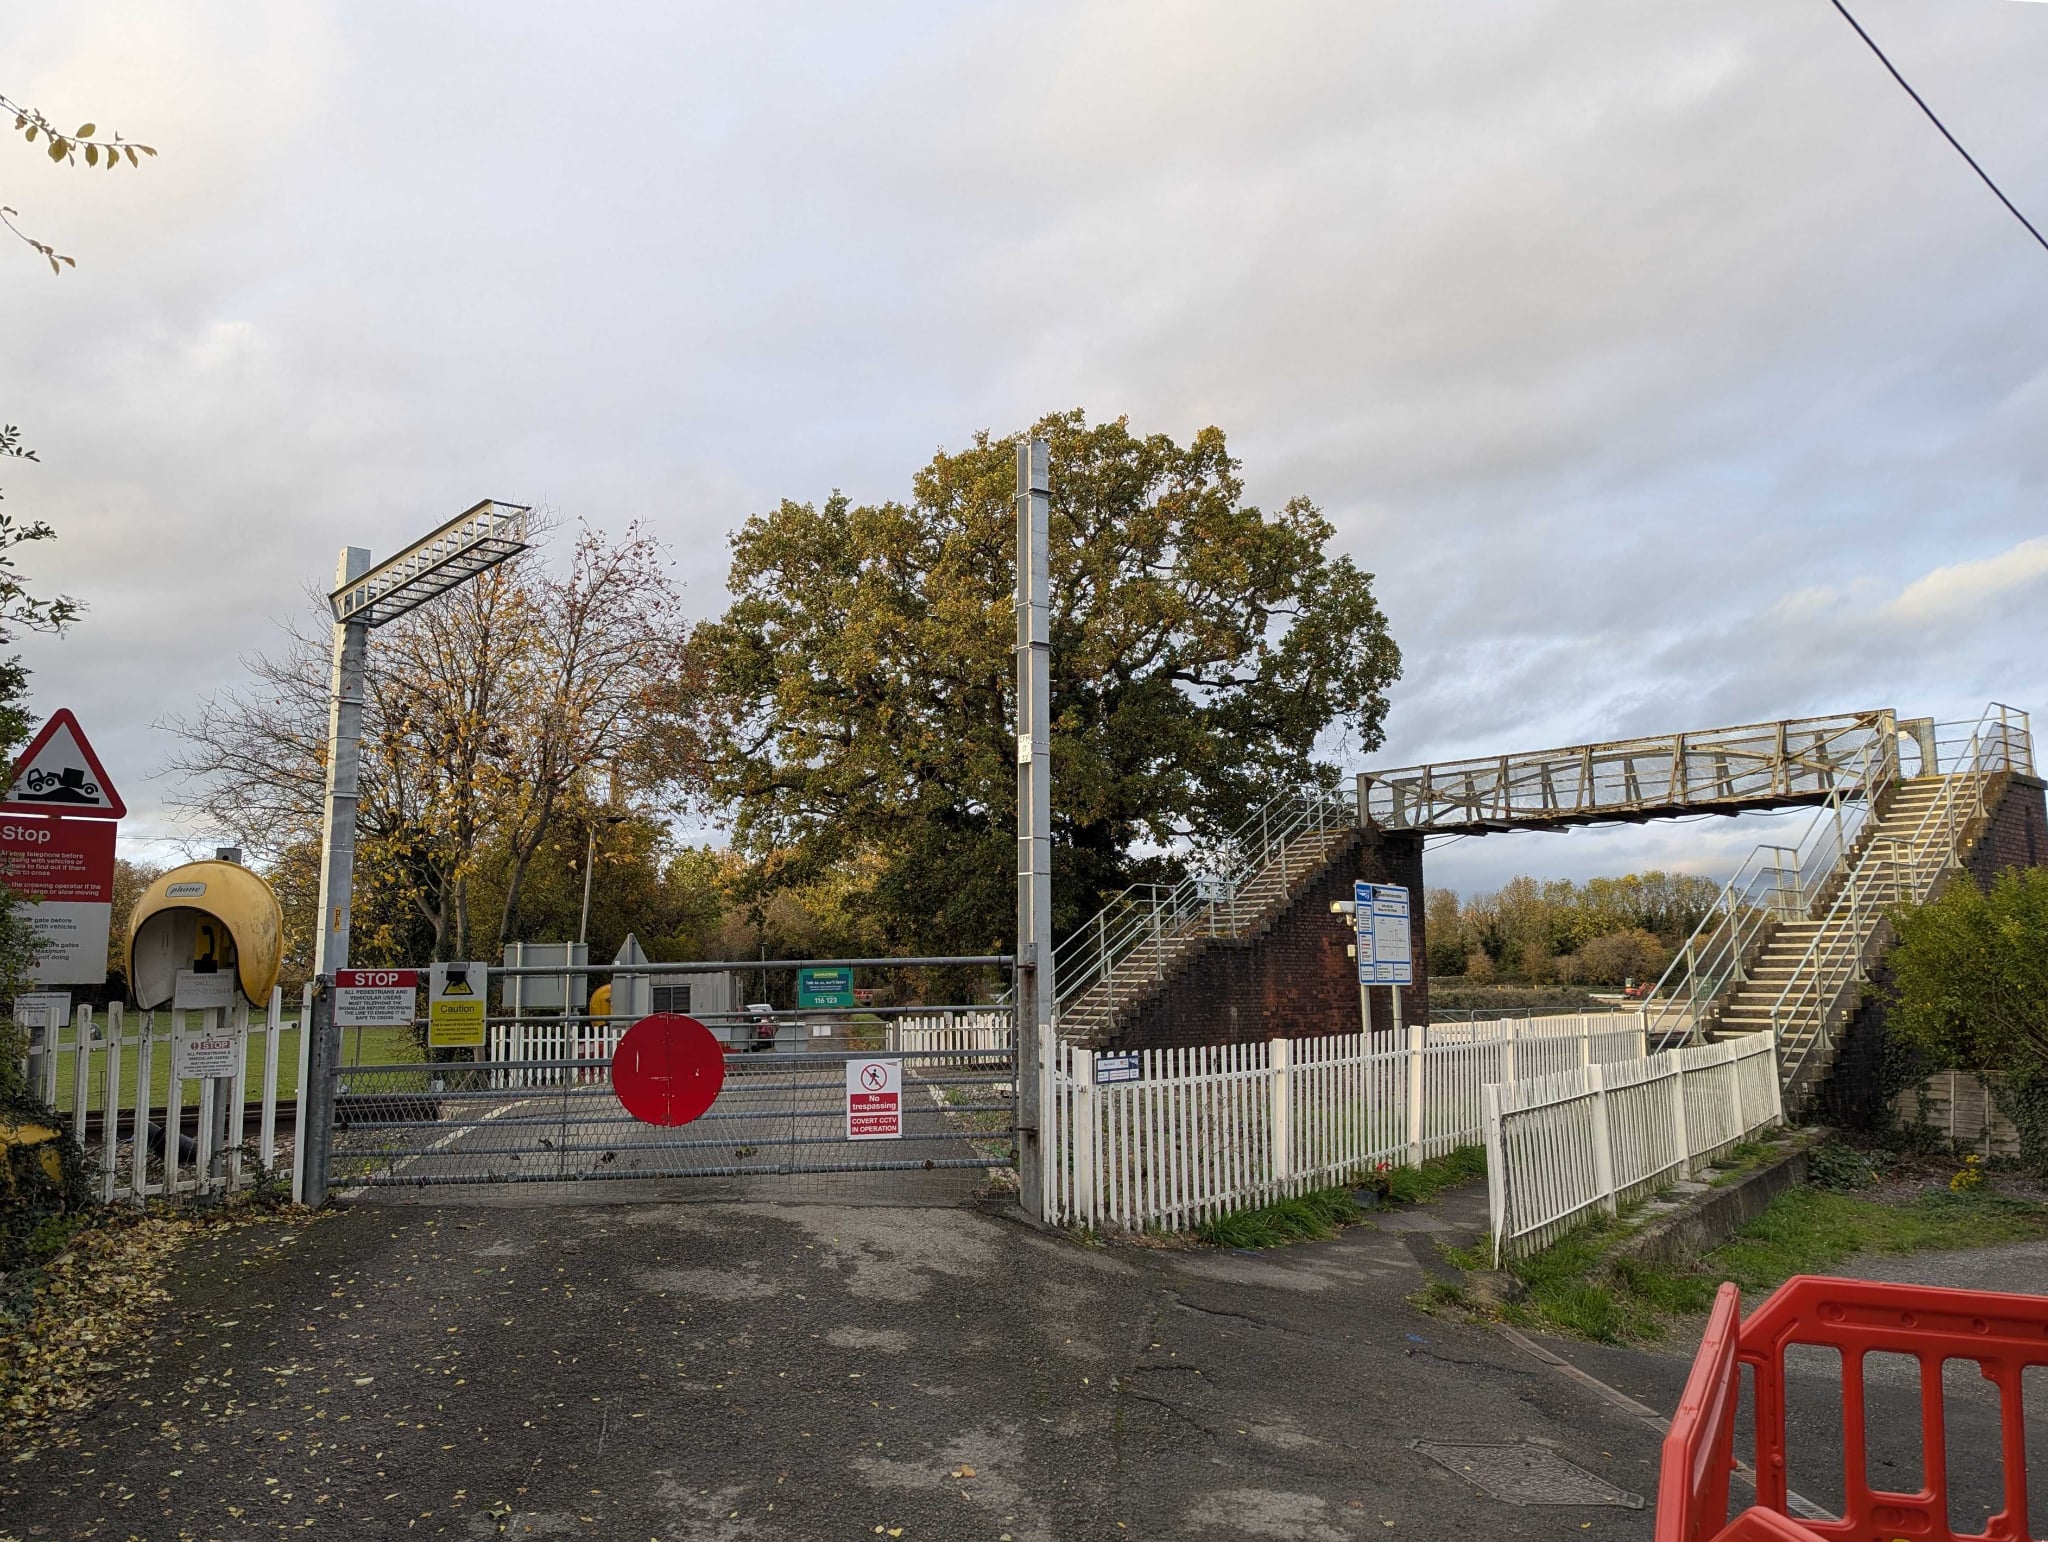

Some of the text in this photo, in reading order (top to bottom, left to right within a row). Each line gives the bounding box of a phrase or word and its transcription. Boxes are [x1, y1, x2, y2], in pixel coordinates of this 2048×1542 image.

[2, 826, 51, 844] Stop
[169, 886, 200, 895] phone
[355, 972, 399, 986] STOP
[440, 1004, 475, 1013] Caution
[852, 1101, 897, 1111] trespassing
[851, 1116, 897, 1125] COVERT CCTV
